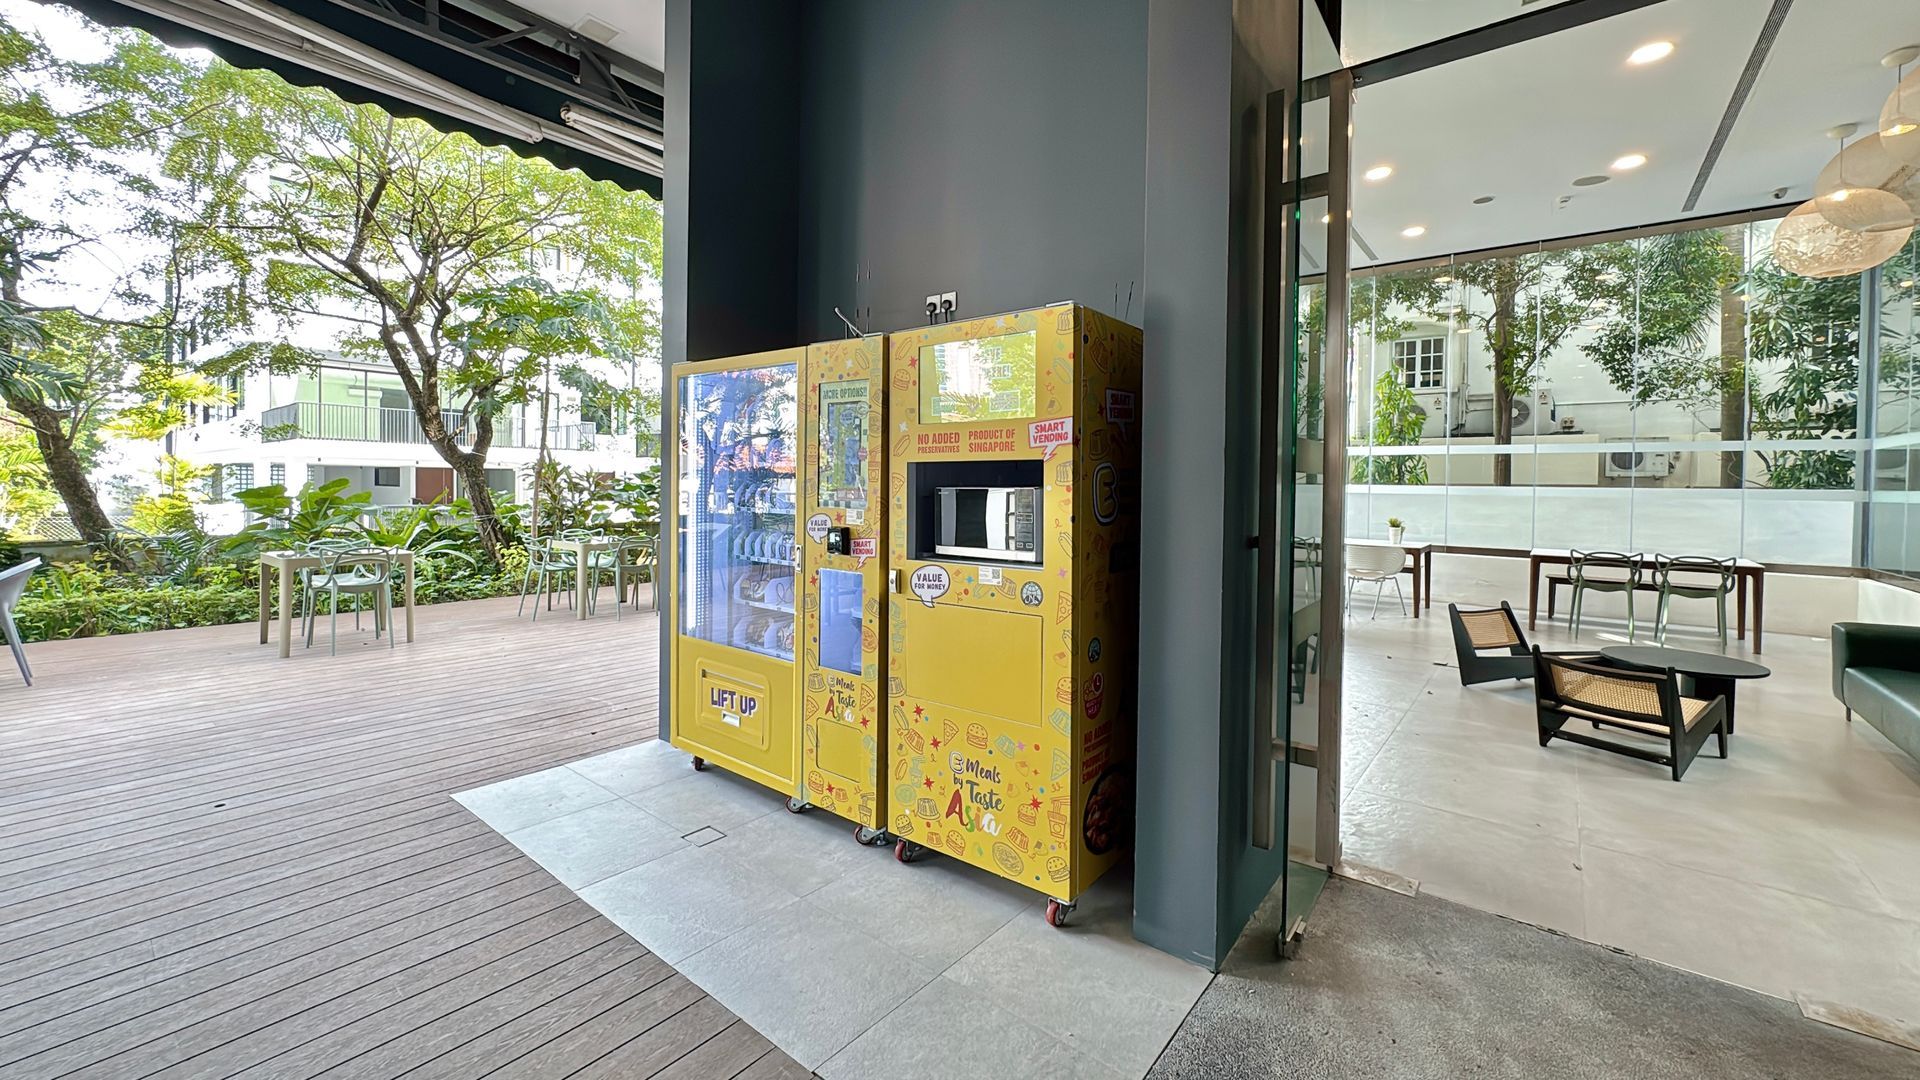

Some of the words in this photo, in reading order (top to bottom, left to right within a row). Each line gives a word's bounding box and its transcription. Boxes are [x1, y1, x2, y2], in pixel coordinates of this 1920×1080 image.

[822, 390, 839, 399] MORE
[1034, 421, 1065, 433] SMART
[917, 434, 930, 445] NO
[932, 432, 960, 444] ADDED
[968, 430, 1003, 440] PRODUCT
[1005, 428, 1016, 439] OF
[1032, 432, 1069, 444] VENDING
[917, 445, 960, 454] PRESERVATIVES
[968, 441, 1016, 453] SINGAPORE
[810, 519, 828, 527] VALUE
[853, 540, 872, 548] SMART
[916, 573, 943, 583] VALUE
[926, 583, 946, 591] MONEY
[710, 687, 737, 710] LIFT
[739, 695, 757, 716] UP
[836, 690, 857, 708] Taste
[825, 696, 855, 723] Asia
[965, 758, 1001, 784] Meals
[953, 773, 964, 790] by
[966, 780, 1005, 812] Taste
[946, 789, 1003, 837] Asia
